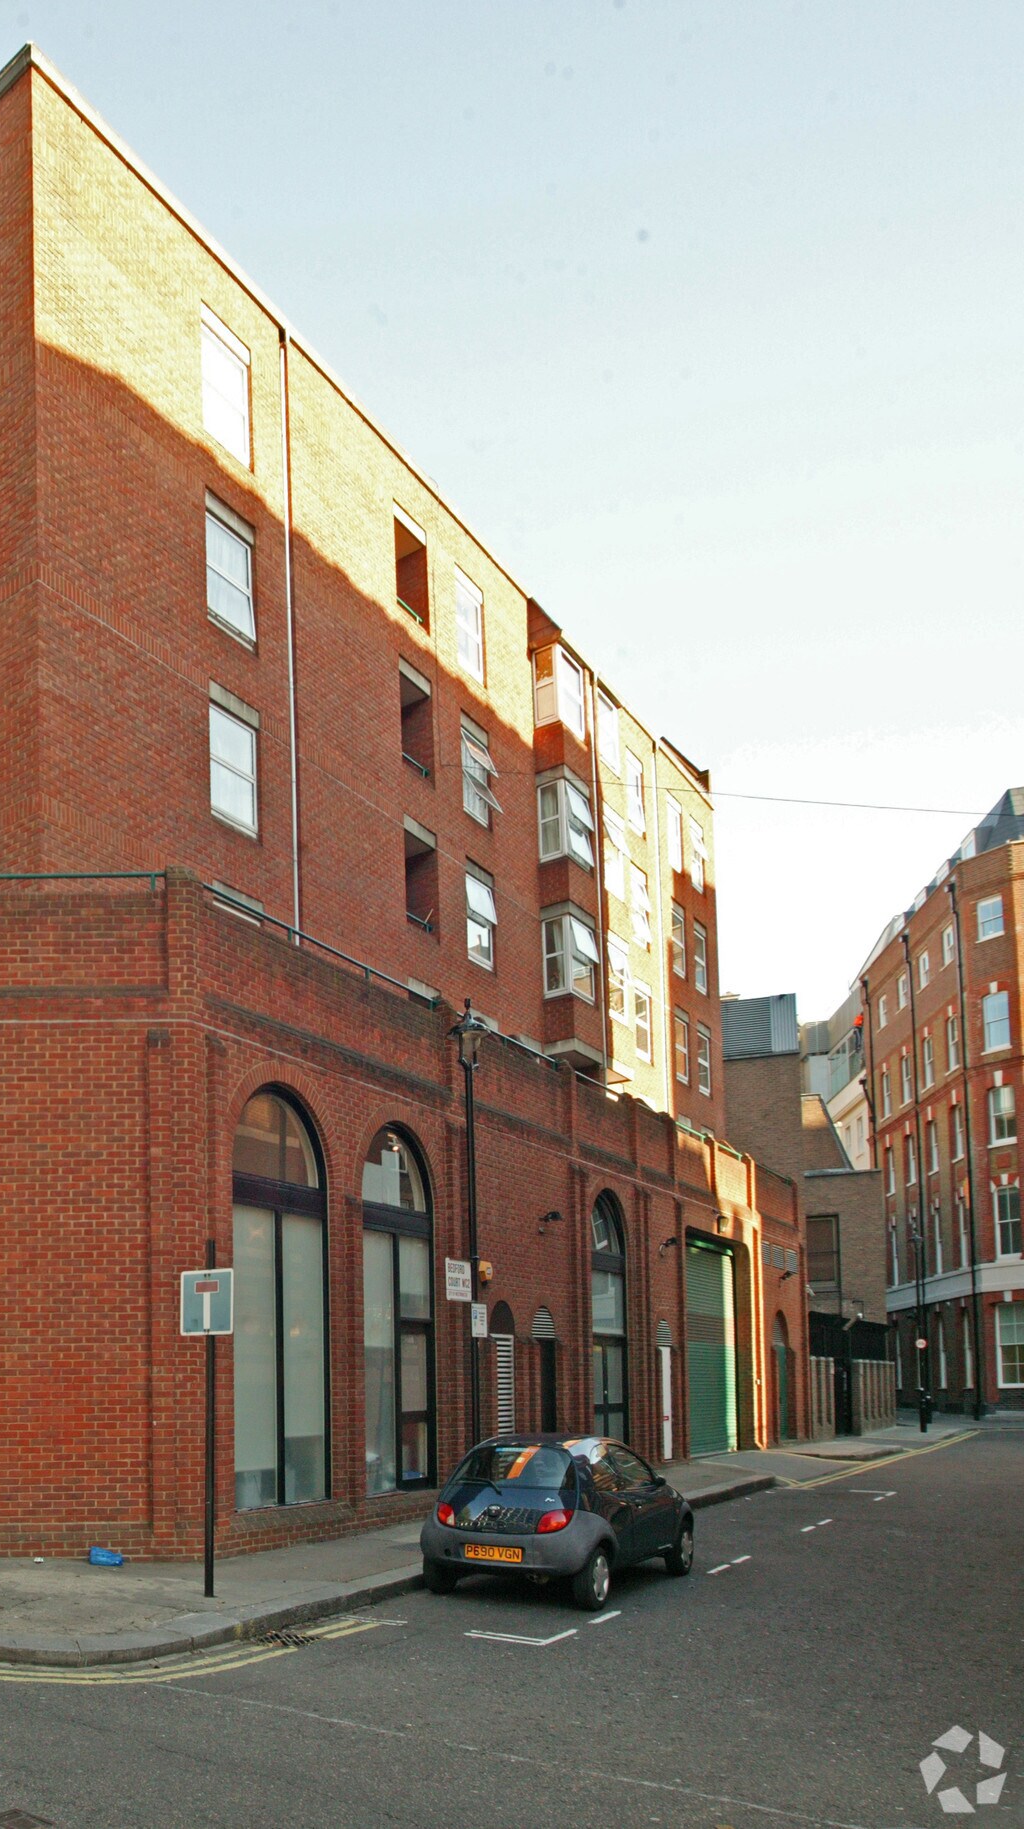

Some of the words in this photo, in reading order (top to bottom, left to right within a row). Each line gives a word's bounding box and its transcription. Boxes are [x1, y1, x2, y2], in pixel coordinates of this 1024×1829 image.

[447, 1262, 465, 1275] BEDFORD
[448, 1276, 461, 1287] COURT
[462, 1278, 470, 1289] WC2
[466, 1545, 495, 1557] P690
[497, 1547, 520, 1560] VGN
